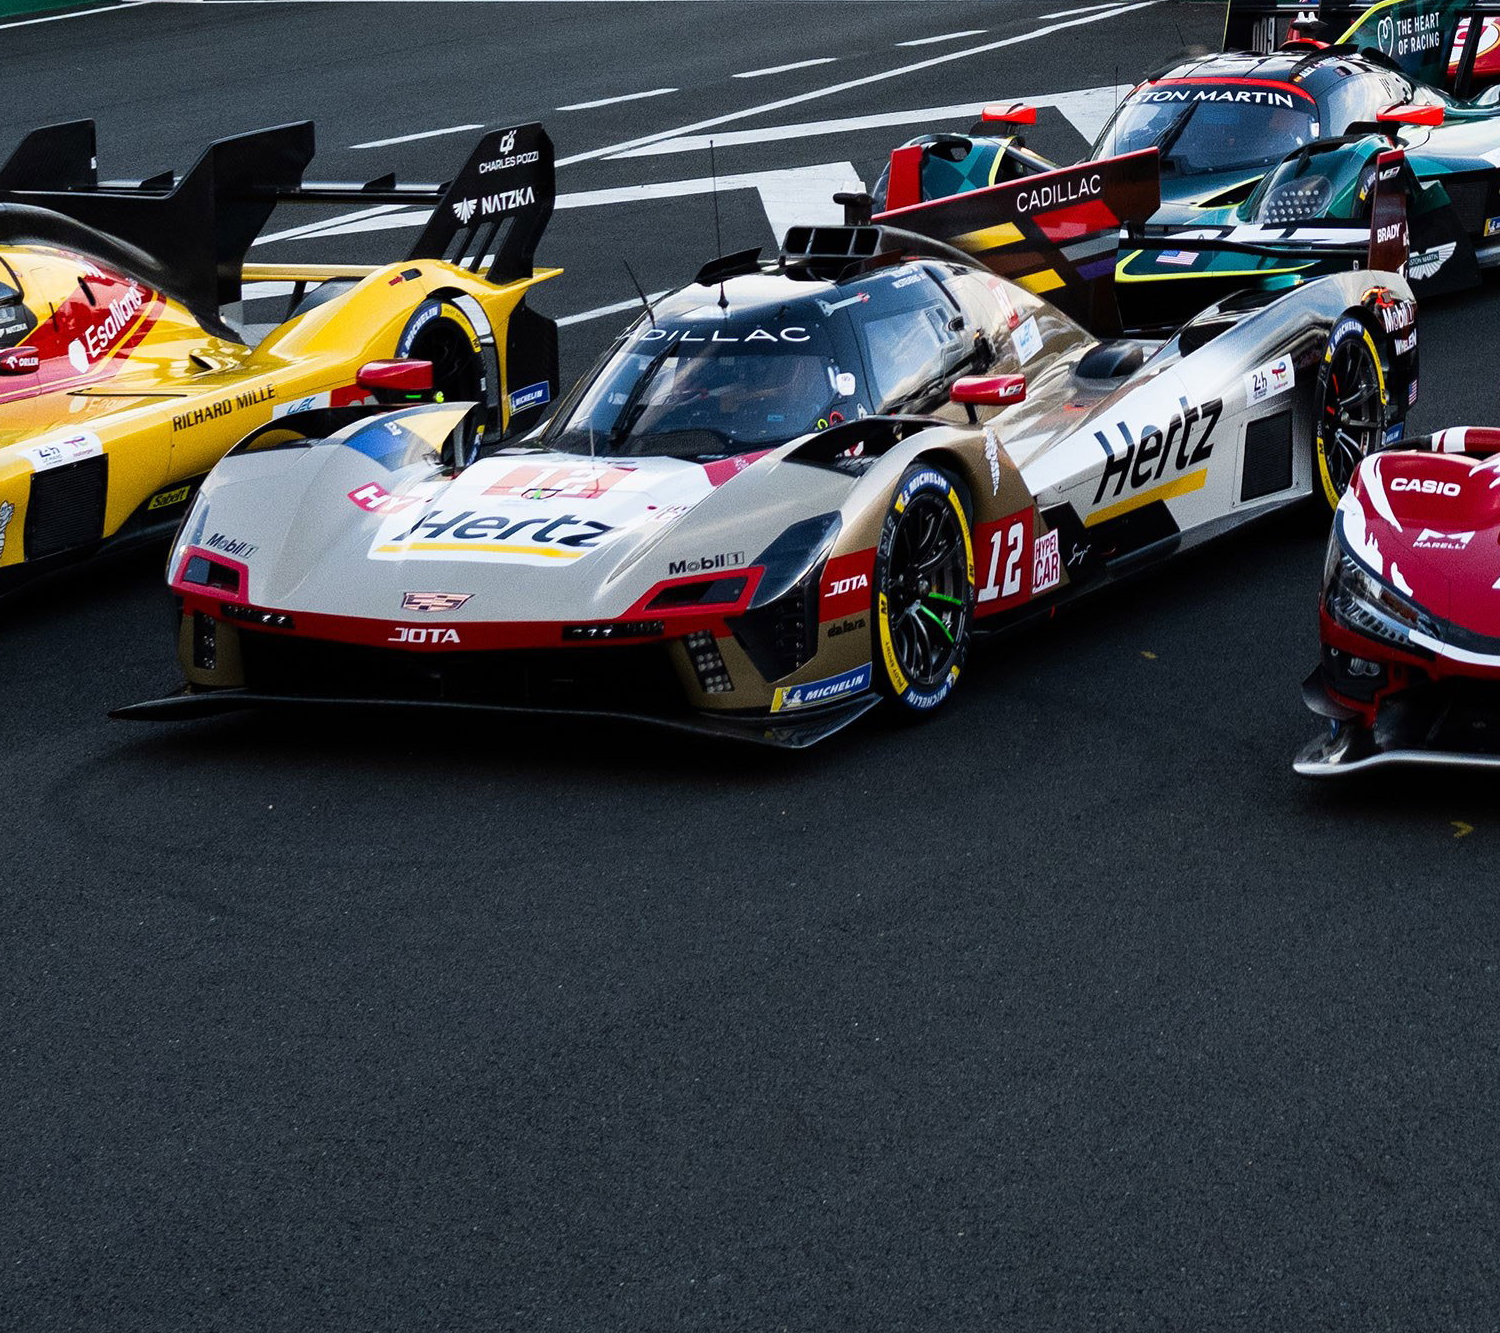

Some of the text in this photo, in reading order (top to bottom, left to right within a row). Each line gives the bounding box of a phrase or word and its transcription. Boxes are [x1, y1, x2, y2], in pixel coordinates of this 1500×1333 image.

[1397, 11, 1440, 36] THE HEART
[1398, 31, 1440, 56] OF RACING
[479, 151, 539, 174] CHARLES POZZI
[482, 186, 535, 215] NATZKA
[1016, 173, 1102, 213] CADILLAC
[1377, 223, 1400, 244] BRADY
[85, 286, 142, 358] EsaNano
[407, 305, 438, 351] MICHELIN
[19, 356, 38, 367] ORLEN
[172, 382, 276, 433] RICHARD MILLE
[1094, 396, 1223, 506] Hertz
[908, 470, 948, 492] MICHELIN
[1390, 477, 1461, 497] CASIO
[153, 488, 186, 508] Sabelt
[392, 510, 613, 547] Hertz
[1413, 540, 1469, 549] MARELLI
[978, 522, 1024, 603] 12
[1034, 551, 1060, 589] CAR
[825, 574, 868, 598] JOTA
[387, 627, 460, 644] JOTA
[805, 674, 865, 701] MICHELIN
